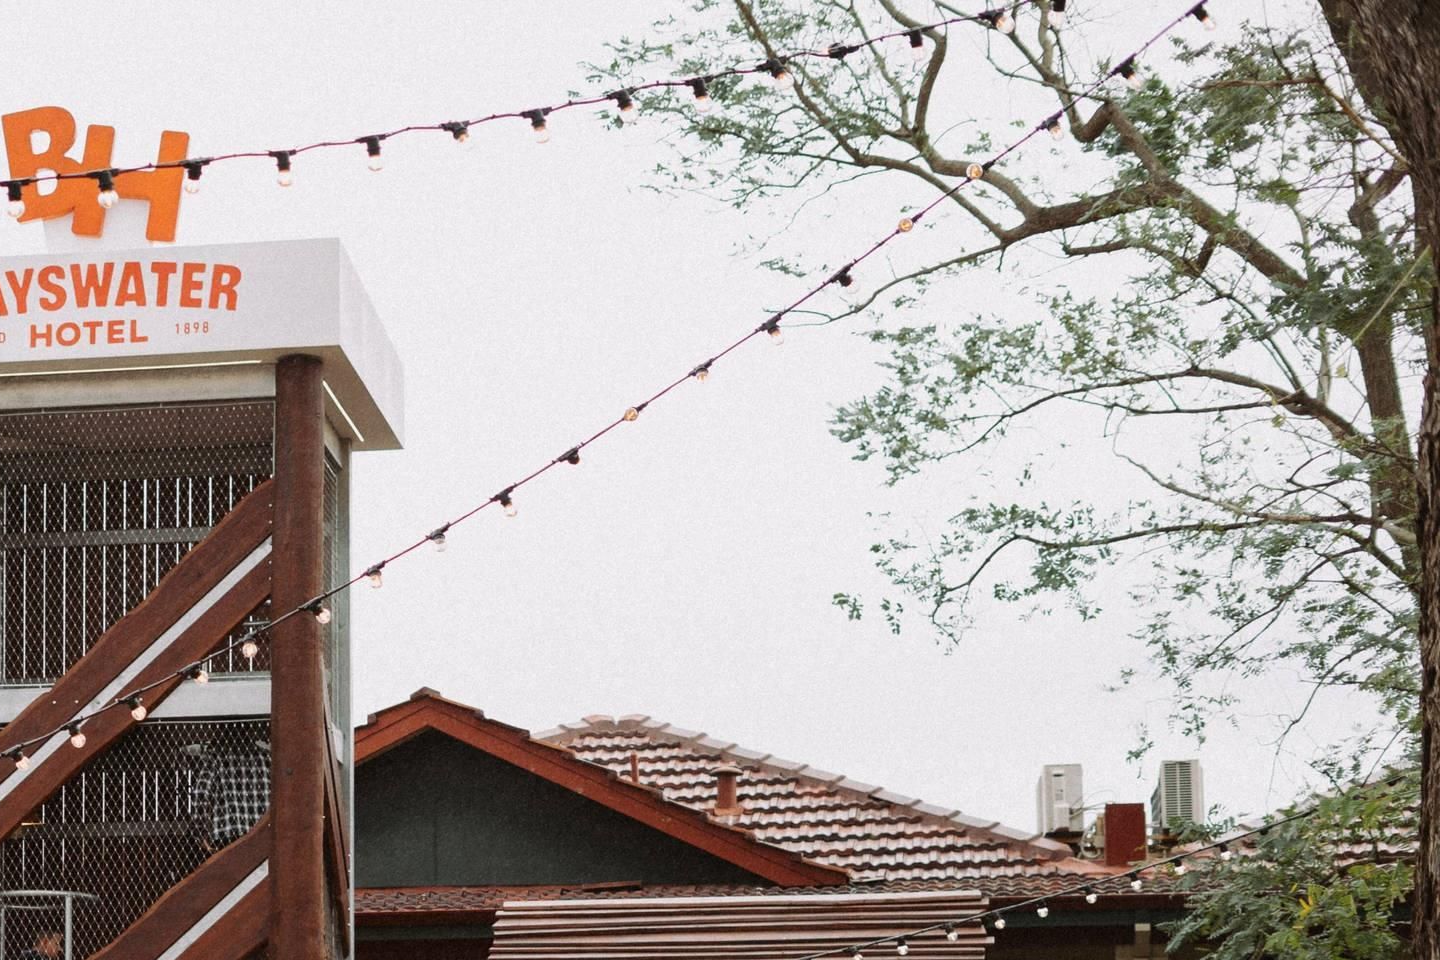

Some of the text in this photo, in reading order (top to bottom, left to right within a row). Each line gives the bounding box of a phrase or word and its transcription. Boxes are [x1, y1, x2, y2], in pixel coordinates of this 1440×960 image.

[1, 106, 190, 242] BH
[30, 319, 149, 348] HOTEL
[175, 321, 209, 334] 1898
